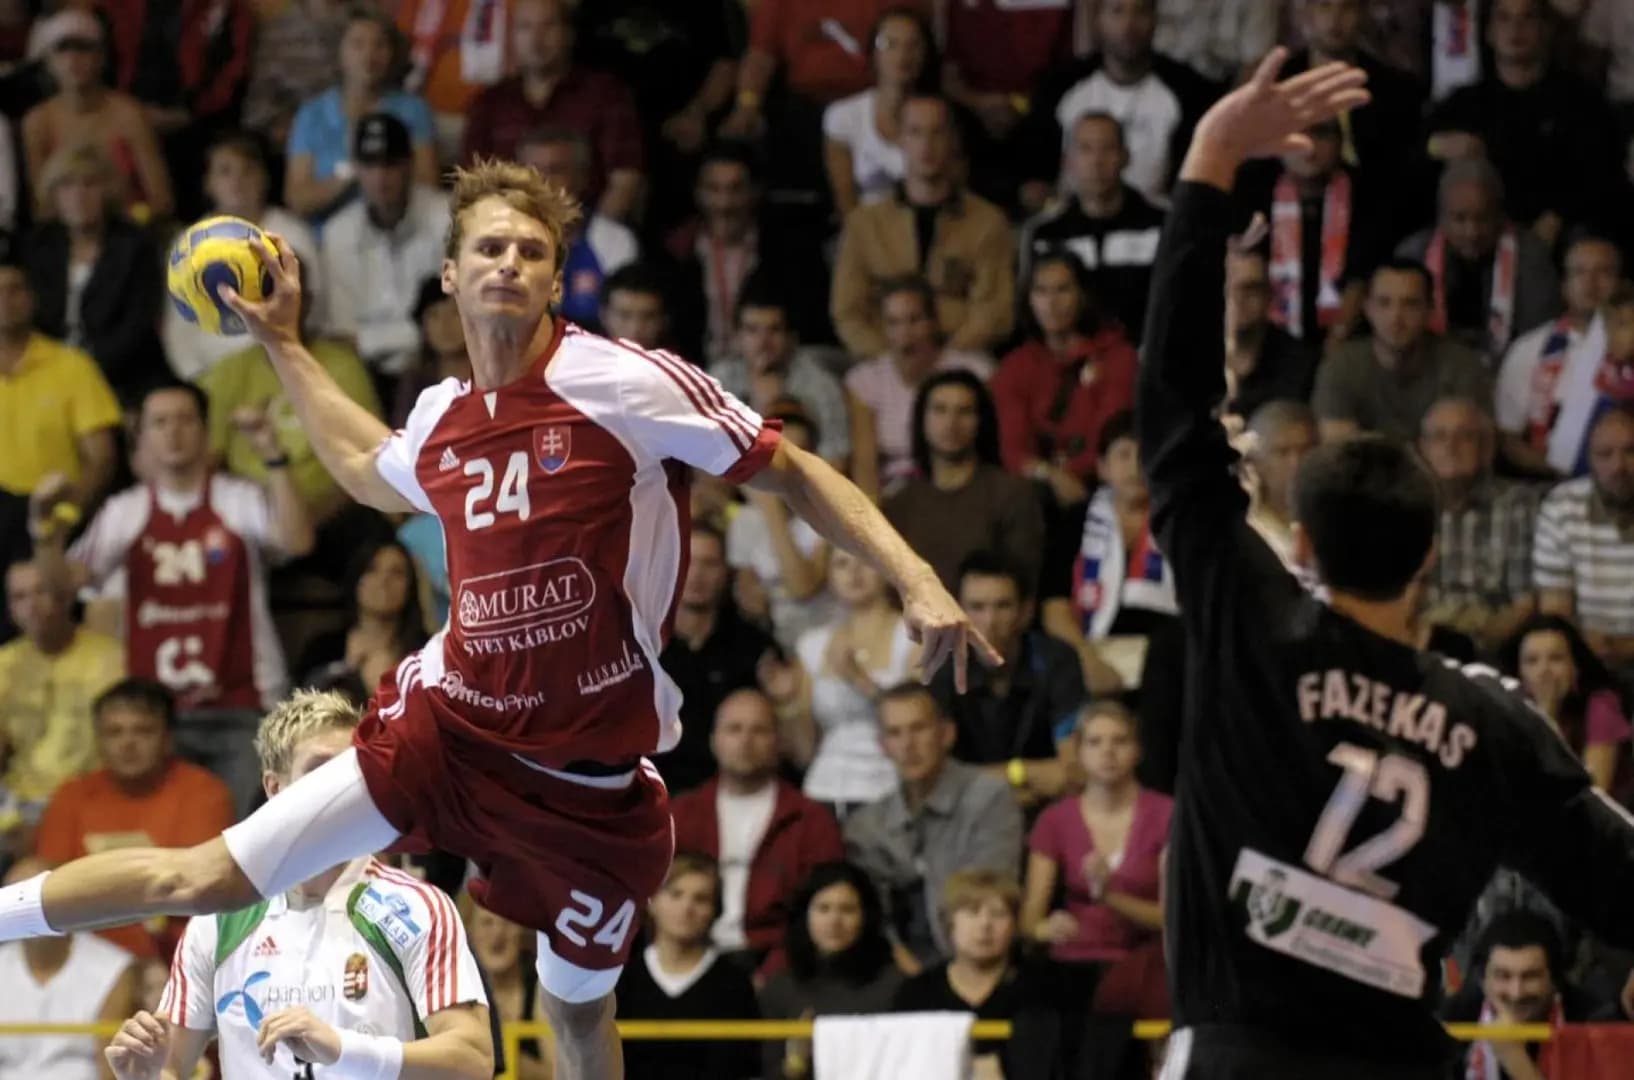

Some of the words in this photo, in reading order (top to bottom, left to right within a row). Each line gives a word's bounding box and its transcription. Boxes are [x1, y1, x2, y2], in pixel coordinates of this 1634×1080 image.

[464, 451, 530, 531] 24
[477, 573, 578, 619] MURAT
[463, 637, 504, 657] SVET
[1297, 669, 1477, 768] FAZEKAS
[1303, 742, 1430, 900] 12
[555, 889, 636, 954] 24
